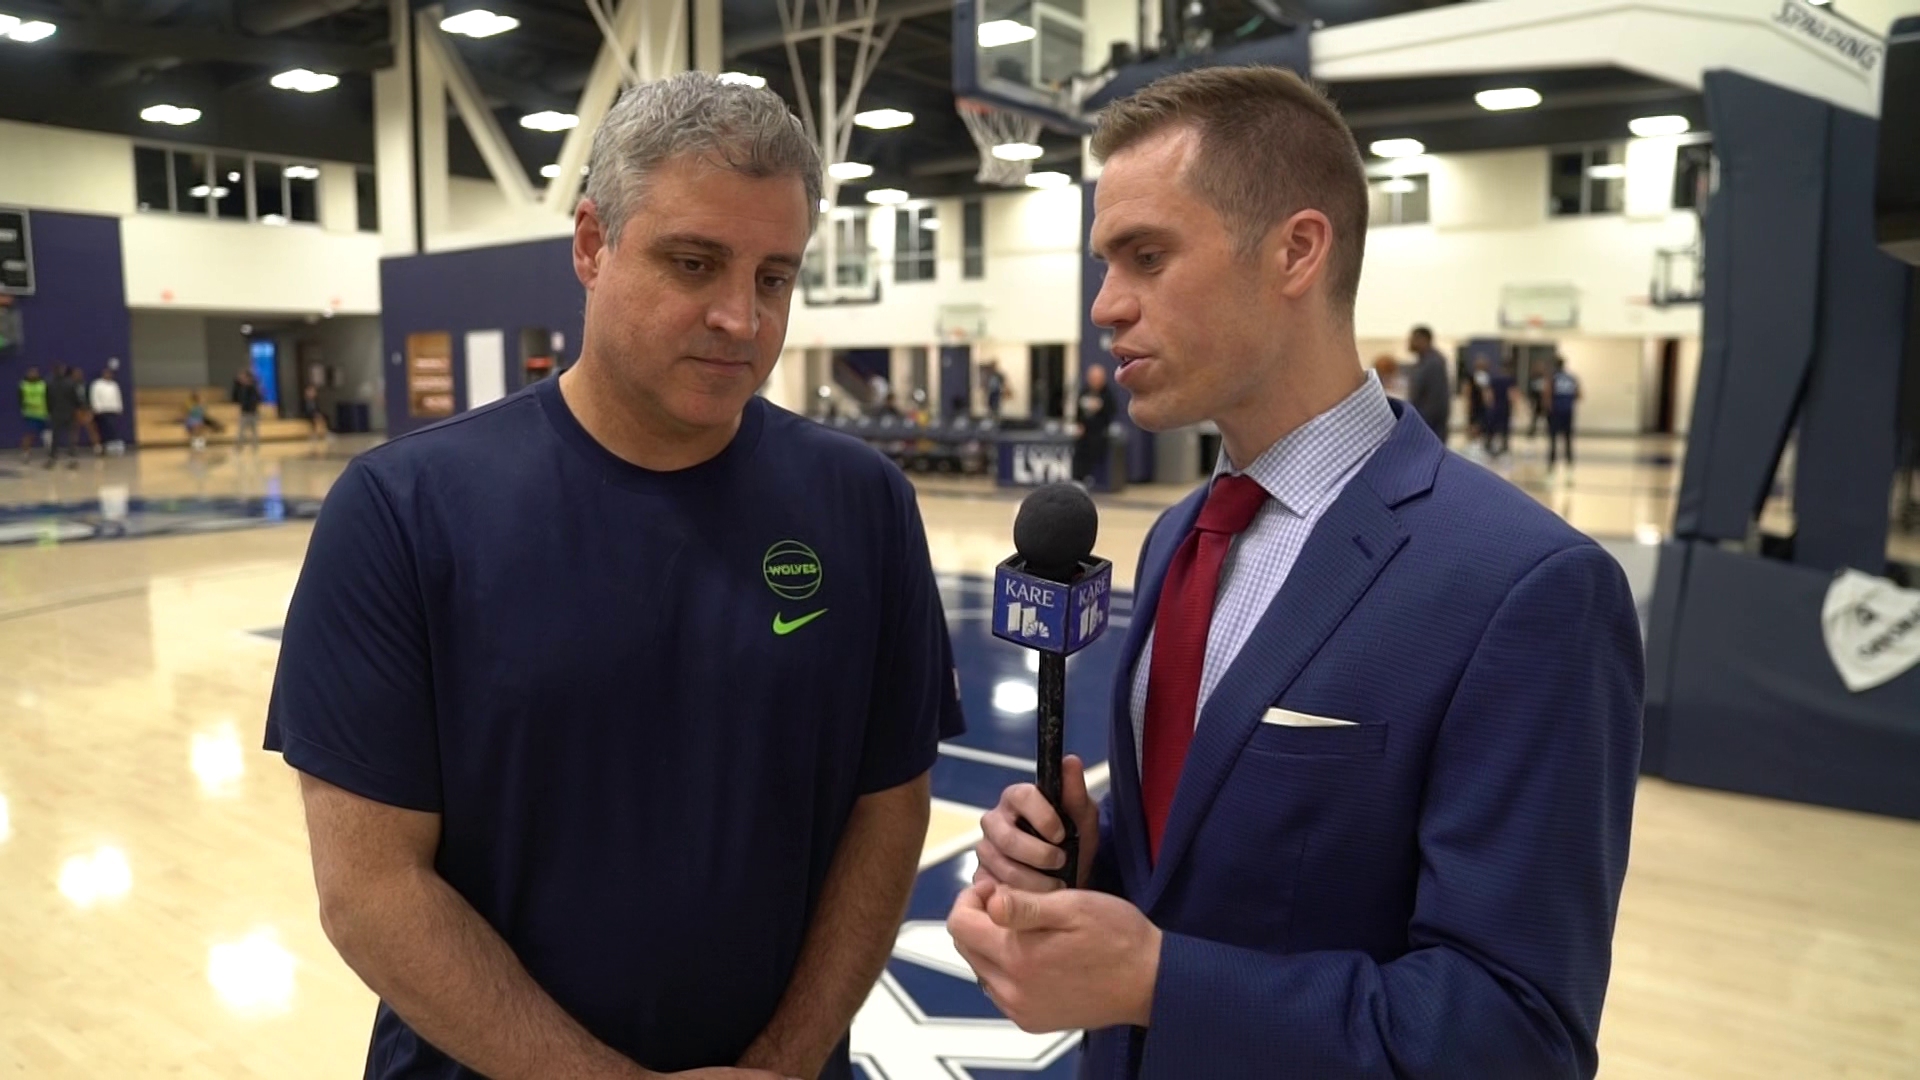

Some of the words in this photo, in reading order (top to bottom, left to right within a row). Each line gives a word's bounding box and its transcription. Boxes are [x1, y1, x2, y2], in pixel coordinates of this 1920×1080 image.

[1772, 0, 1881, 71] SPALDING
[768, 563, 817, 576] WOLVES
[1005, 578, 1055, 608] KARE
[1079, 576, 1108, 607] KARE
